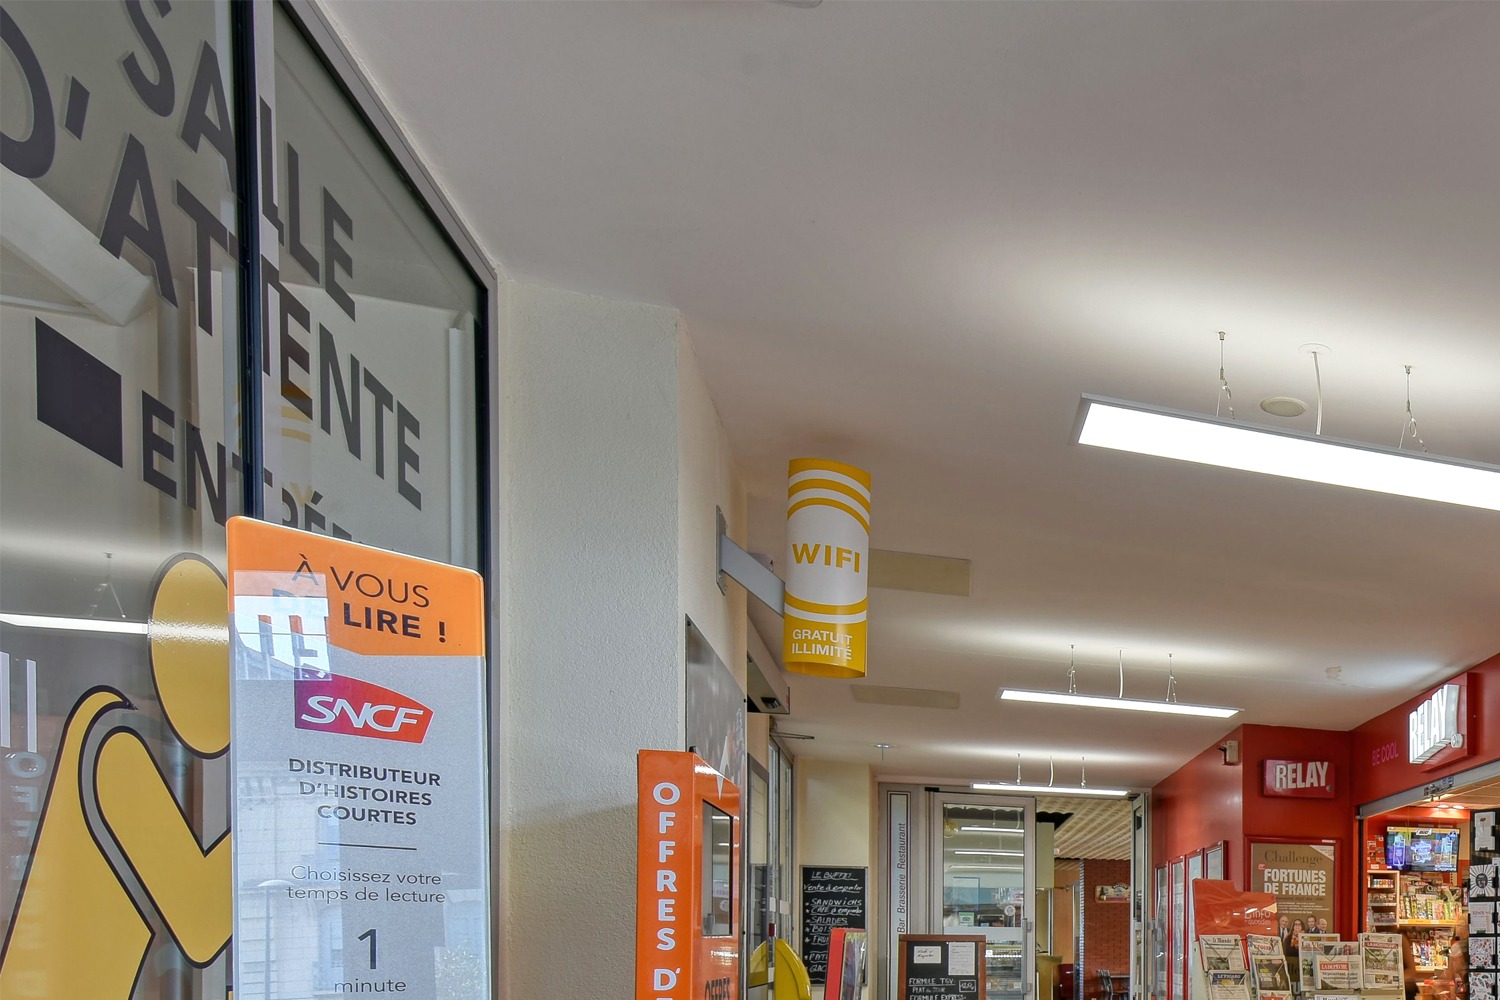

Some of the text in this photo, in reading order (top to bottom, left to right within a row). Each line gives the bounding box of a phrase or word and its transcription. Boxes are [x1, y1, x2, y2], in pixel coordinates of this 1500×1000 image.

[122, 0, 356, 322] SALLE
[792, 543, 860, 573] WIFI
[292, 553, 319, 586] À
[330, 565, 430, 608] VOUS
[343, 602, 421, 638] LIRE
[791, 642, 853, 660] ILLIMITÉ
[792, 629, 853, 646] GRATUIT
[301, 695, 424, 732] SNCF
[1409, 684, 1455, 763] RELAY
[1372, 741, 1399, 766] BE COOL
[288, 758, 441, 786] DISTRIBUTEUR
[1275, 761, 1328, 790] RELAY
[299, 781, 432, 806] D'HISTOIRES
[317, 805, 417, 826] COURTES
[291, 865, 442, 886] Choisissez votre
[652, 781, 681, 951] OFFRES
[897, 822, 906, 934] Bar Brasserie Restaurant
[1264, 868, 1326, 883] FORTUNES
[286, 886, 446, 904] temps de lecture
[1264, 882, 1326, 896] DE FRANCE
[357, 929, 377, 970] 1
[334, 977, 407, 993] minute
